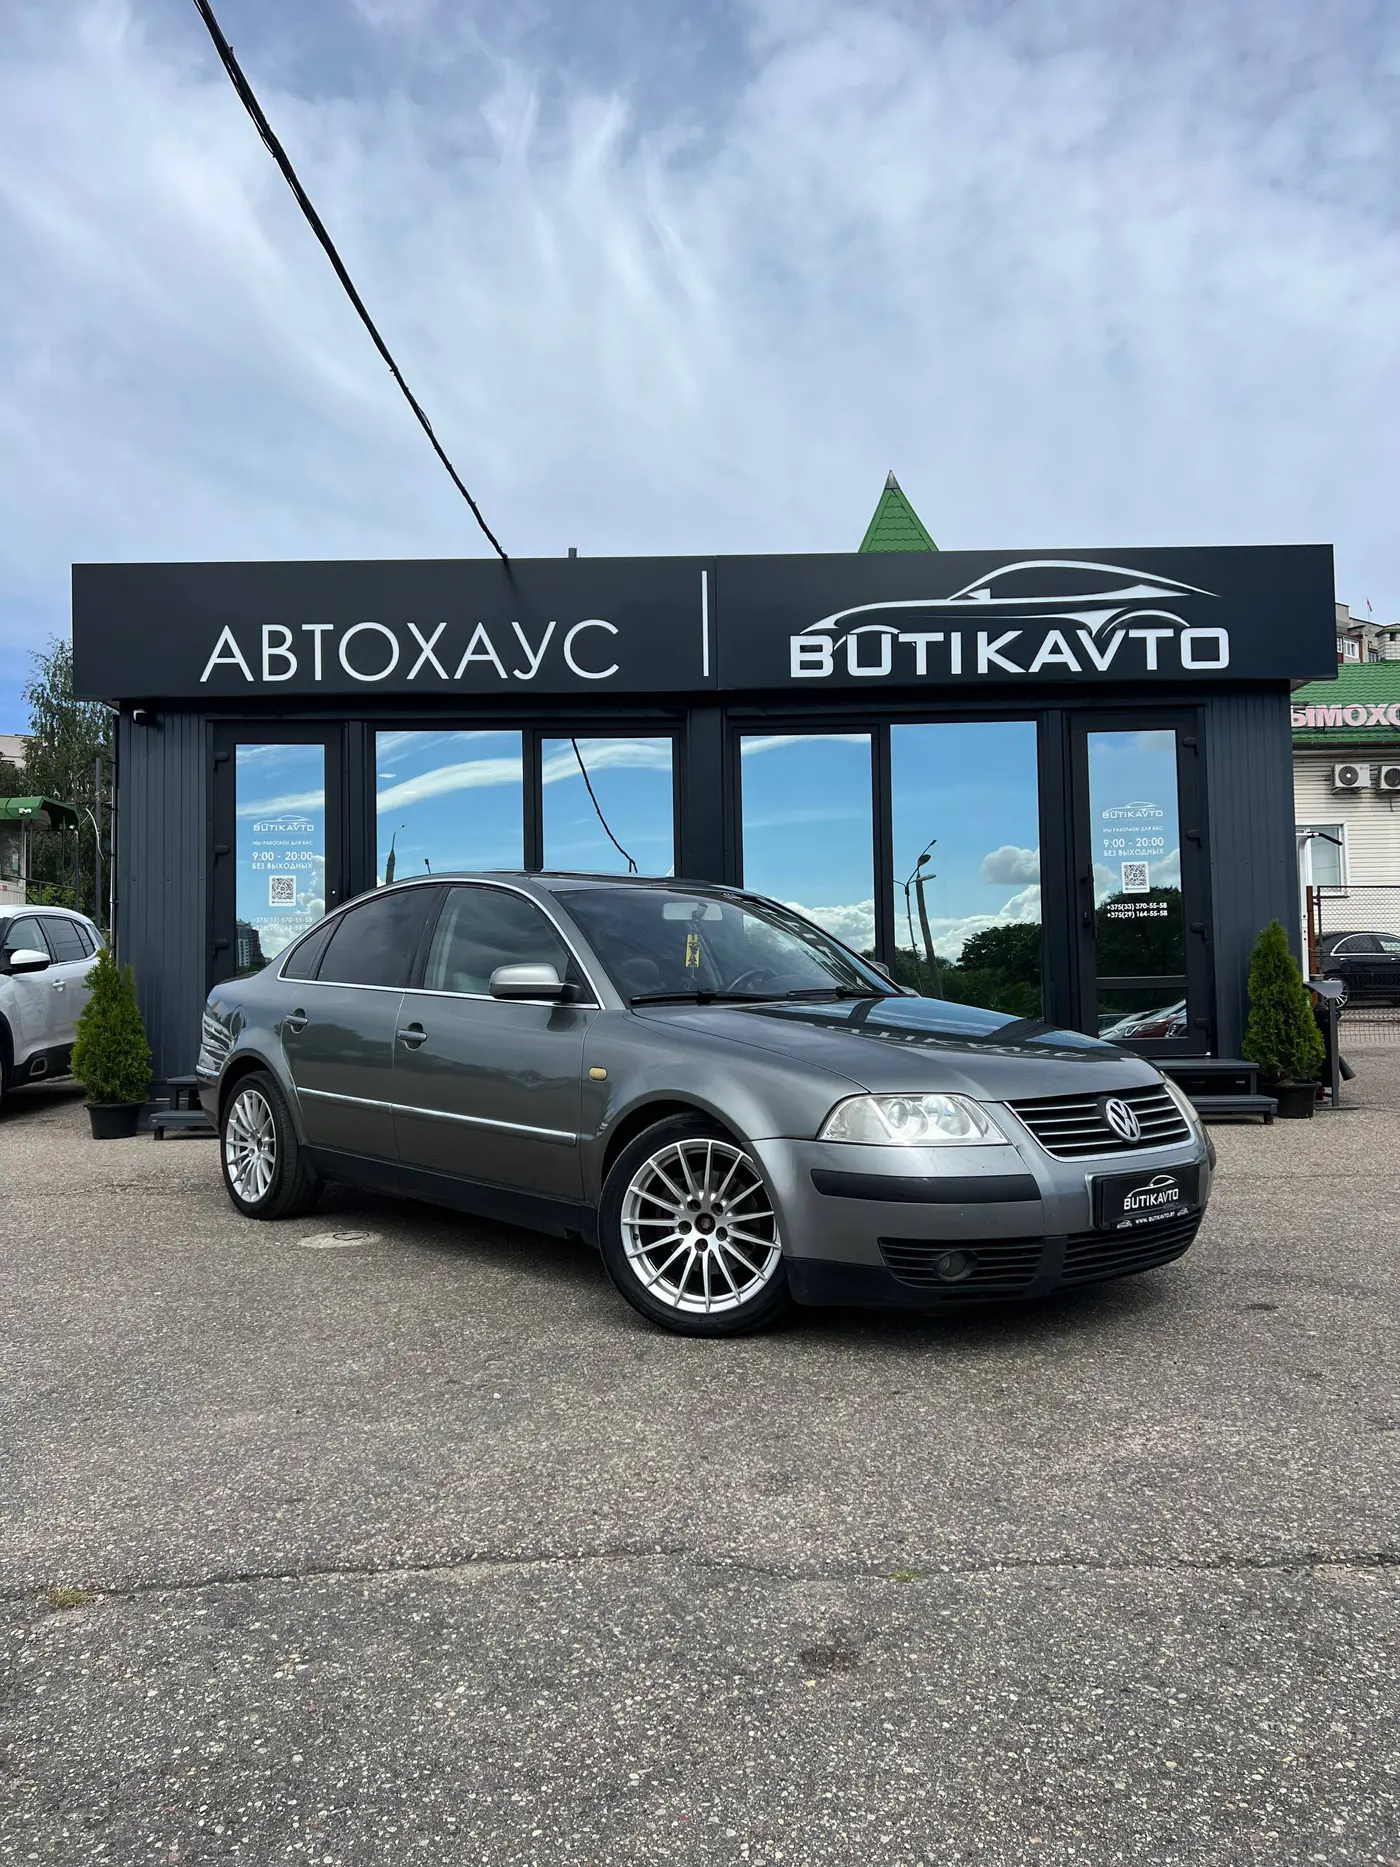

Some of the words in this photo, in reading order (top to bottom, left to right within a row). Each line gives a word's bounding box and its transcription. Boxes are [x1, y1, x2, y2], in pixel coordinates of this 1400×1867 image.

[200, 619, 620, 682] АВТОХАУС
[790, 627, 1230, 677] BUTIKAVTO
[1102, 810, 1164, 819] BUTIKAVTO
[253, 824, 315, 832] BUTIKAVTO
[1103, 838, 1125, 848] 9:00
[1135, 837, 1164, 847] 20:00
[252, 852, 274, 861] 9:00
[285, 852, 313, 861] 20:00
[1118, 848, 1164, 856] ВЫХОДНЫХ
[252, 862, 265, 870] БЕЗ
[267, 862, 313, 870] ВЫХОДНЫХ
[1106, 903, 1135, 911] +375(33)
[1135, 902, 1168, 910] 370-55-58
[1106, 911, 1135, 919] +375(29)
[1123, 1188, 1179, 1210] BUTIKAVTO
